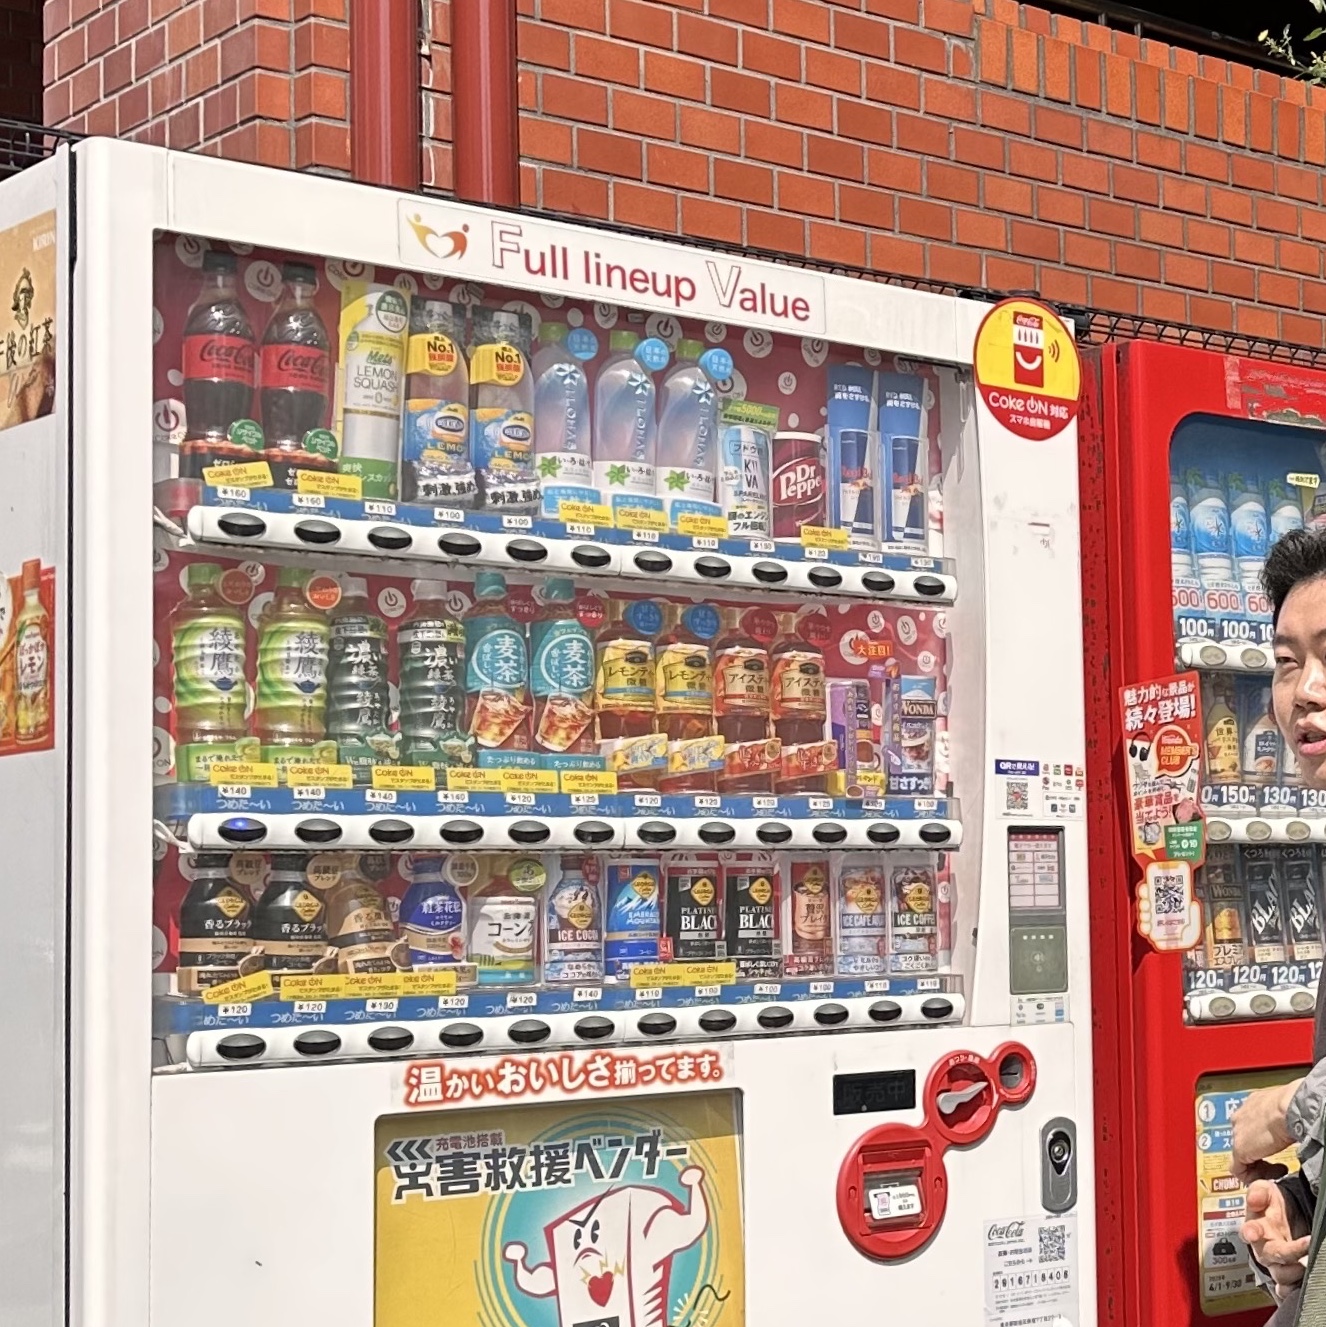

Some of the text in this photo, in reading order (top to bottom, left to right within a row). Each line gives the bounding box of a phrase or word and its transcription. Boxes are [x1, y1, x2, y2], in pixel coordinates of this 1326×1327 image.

[491, 221, 811, 321] Full lineup Value
[989, 391, 1025, 410] Coke
[1026, 396, 1049, 416] ON
[797, 465, 816, 480] Dr
[1207, 592, 1239, 611] 600
[1179, 617, 1214, 637] 100円
[1222, 620, 1256, 640] 100円
[494, 635, 517, 683] 麦茶
[563, 639, 587, 688] 麦茶
[1125, 694, 1196, 731] 続々登場!
[1220, 786, 1256, 803] 150円
[1263, 786, 1296, 804] 130円
[680, 914, 717, 931] BLAC
[739, 913, 775, 930] BLAC
[897, 913, 911, 926] ICE
[558, 929, 574, 941] ICE
[1189, 971, 1224, 990] 120円
[1233, 965, 1266, 983] 120円
[1271, 966, 1305, 983] 120円
[408, 1053, 722, 1103] 温かいおいしさ揃ってます。
[435, 1131, 503, 1150] 充電池搭載
[387, 1130, 688, 1201] 災害救援ベンダー
[1213, 1178, 1239, 1191] CHUMS
